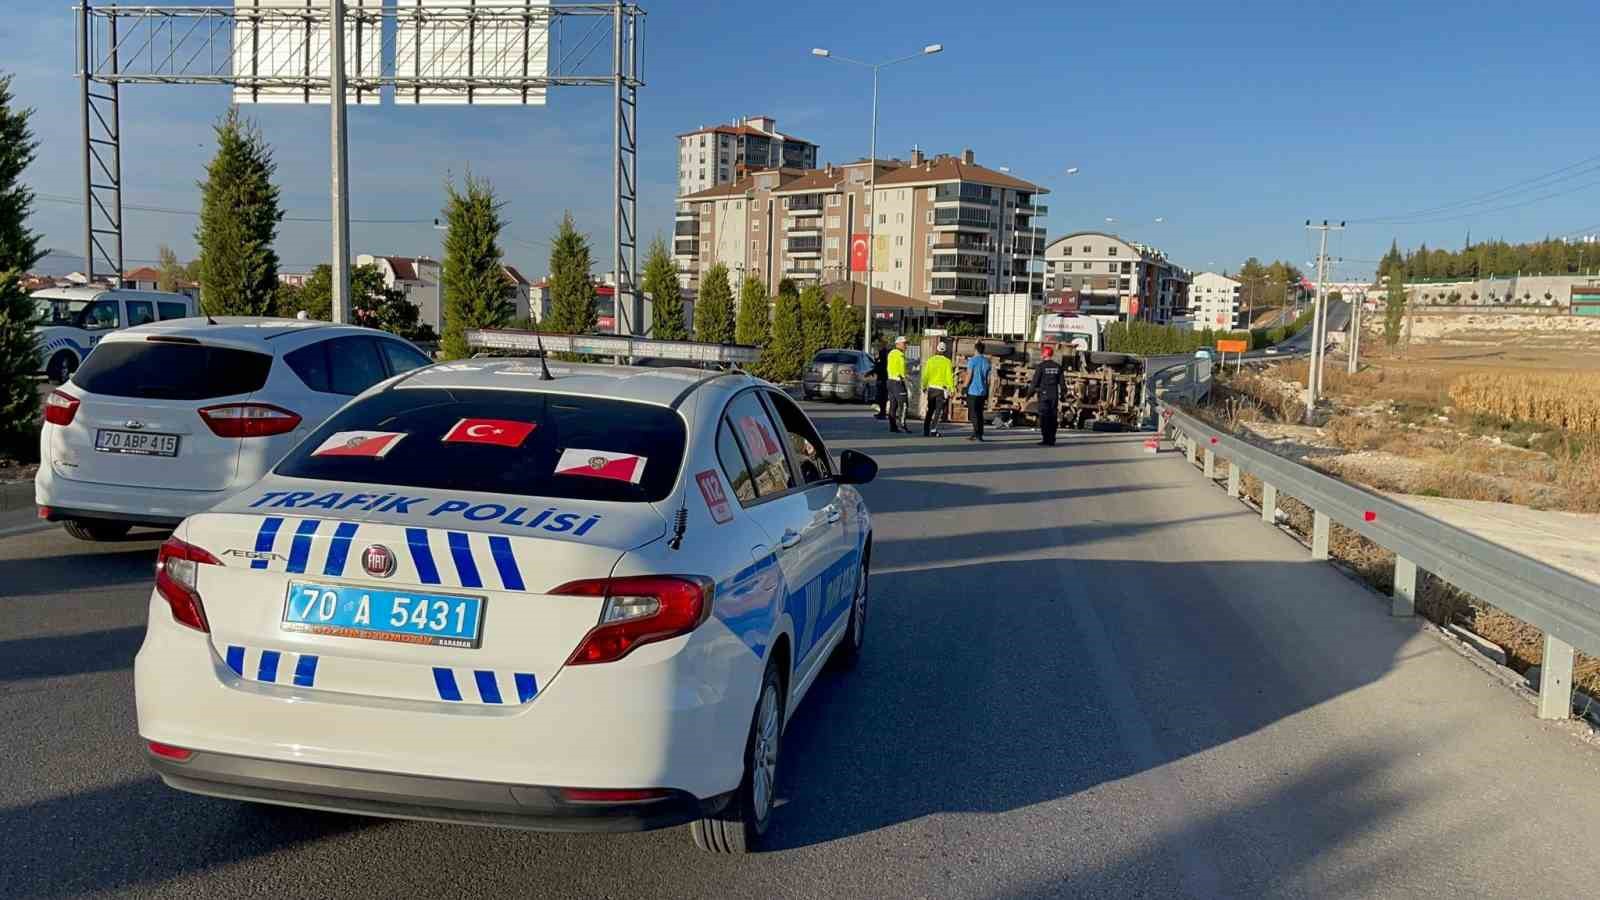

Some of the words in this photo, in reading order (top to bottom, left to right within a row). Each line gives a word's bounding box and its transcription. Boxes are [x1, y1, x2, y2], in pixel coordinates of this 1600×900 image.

[105, 433, 120, 446] 70
[123, 434, 148, 448] ABP
[151, 435, 174, 450] 415
[250, 492, 428, 514] TRAFİK
[428, 500, 601, 536] POLİSİ
[367, 553, 386, 570] FIAT
[301, 590, 337, 621] 70
[353, 595, 370, 624] A
[390, 597, 467, 633] 5431
